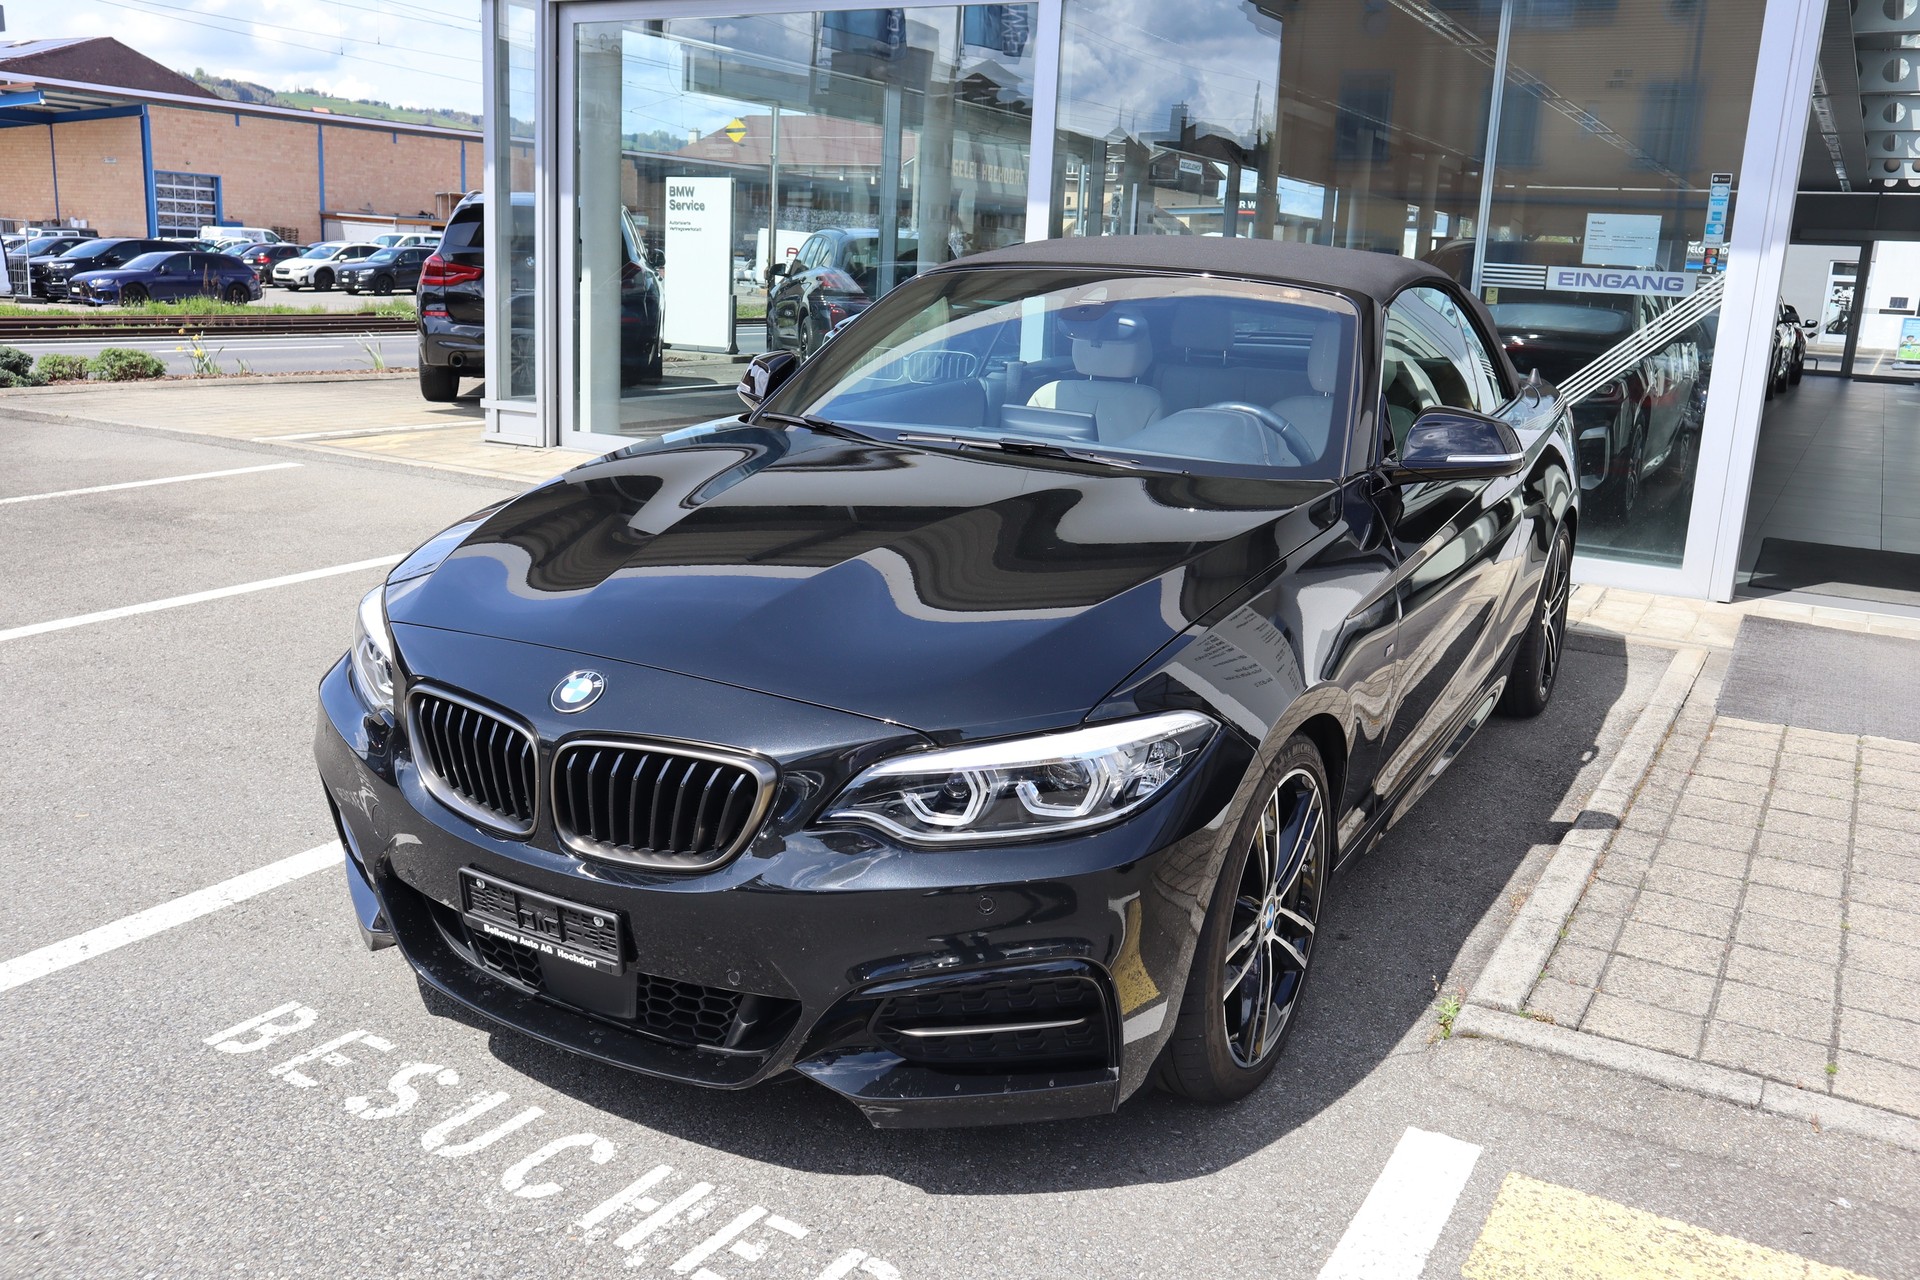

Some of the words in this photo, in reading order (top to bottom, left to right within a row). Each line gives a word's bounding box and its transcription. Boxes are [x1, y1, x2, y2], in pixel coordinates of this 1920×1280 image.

[669, 186, 694, 197] BMW
[669, 199, 705, 211] Service
[1557, 271, 1684, 292] EINGANG
[484, 923, 518, 942] Bellevue
[519, 936, 539, 950] Auto
[540, 943, 553, 954] AG
[557, 949, 597, 968] Hochdorf
